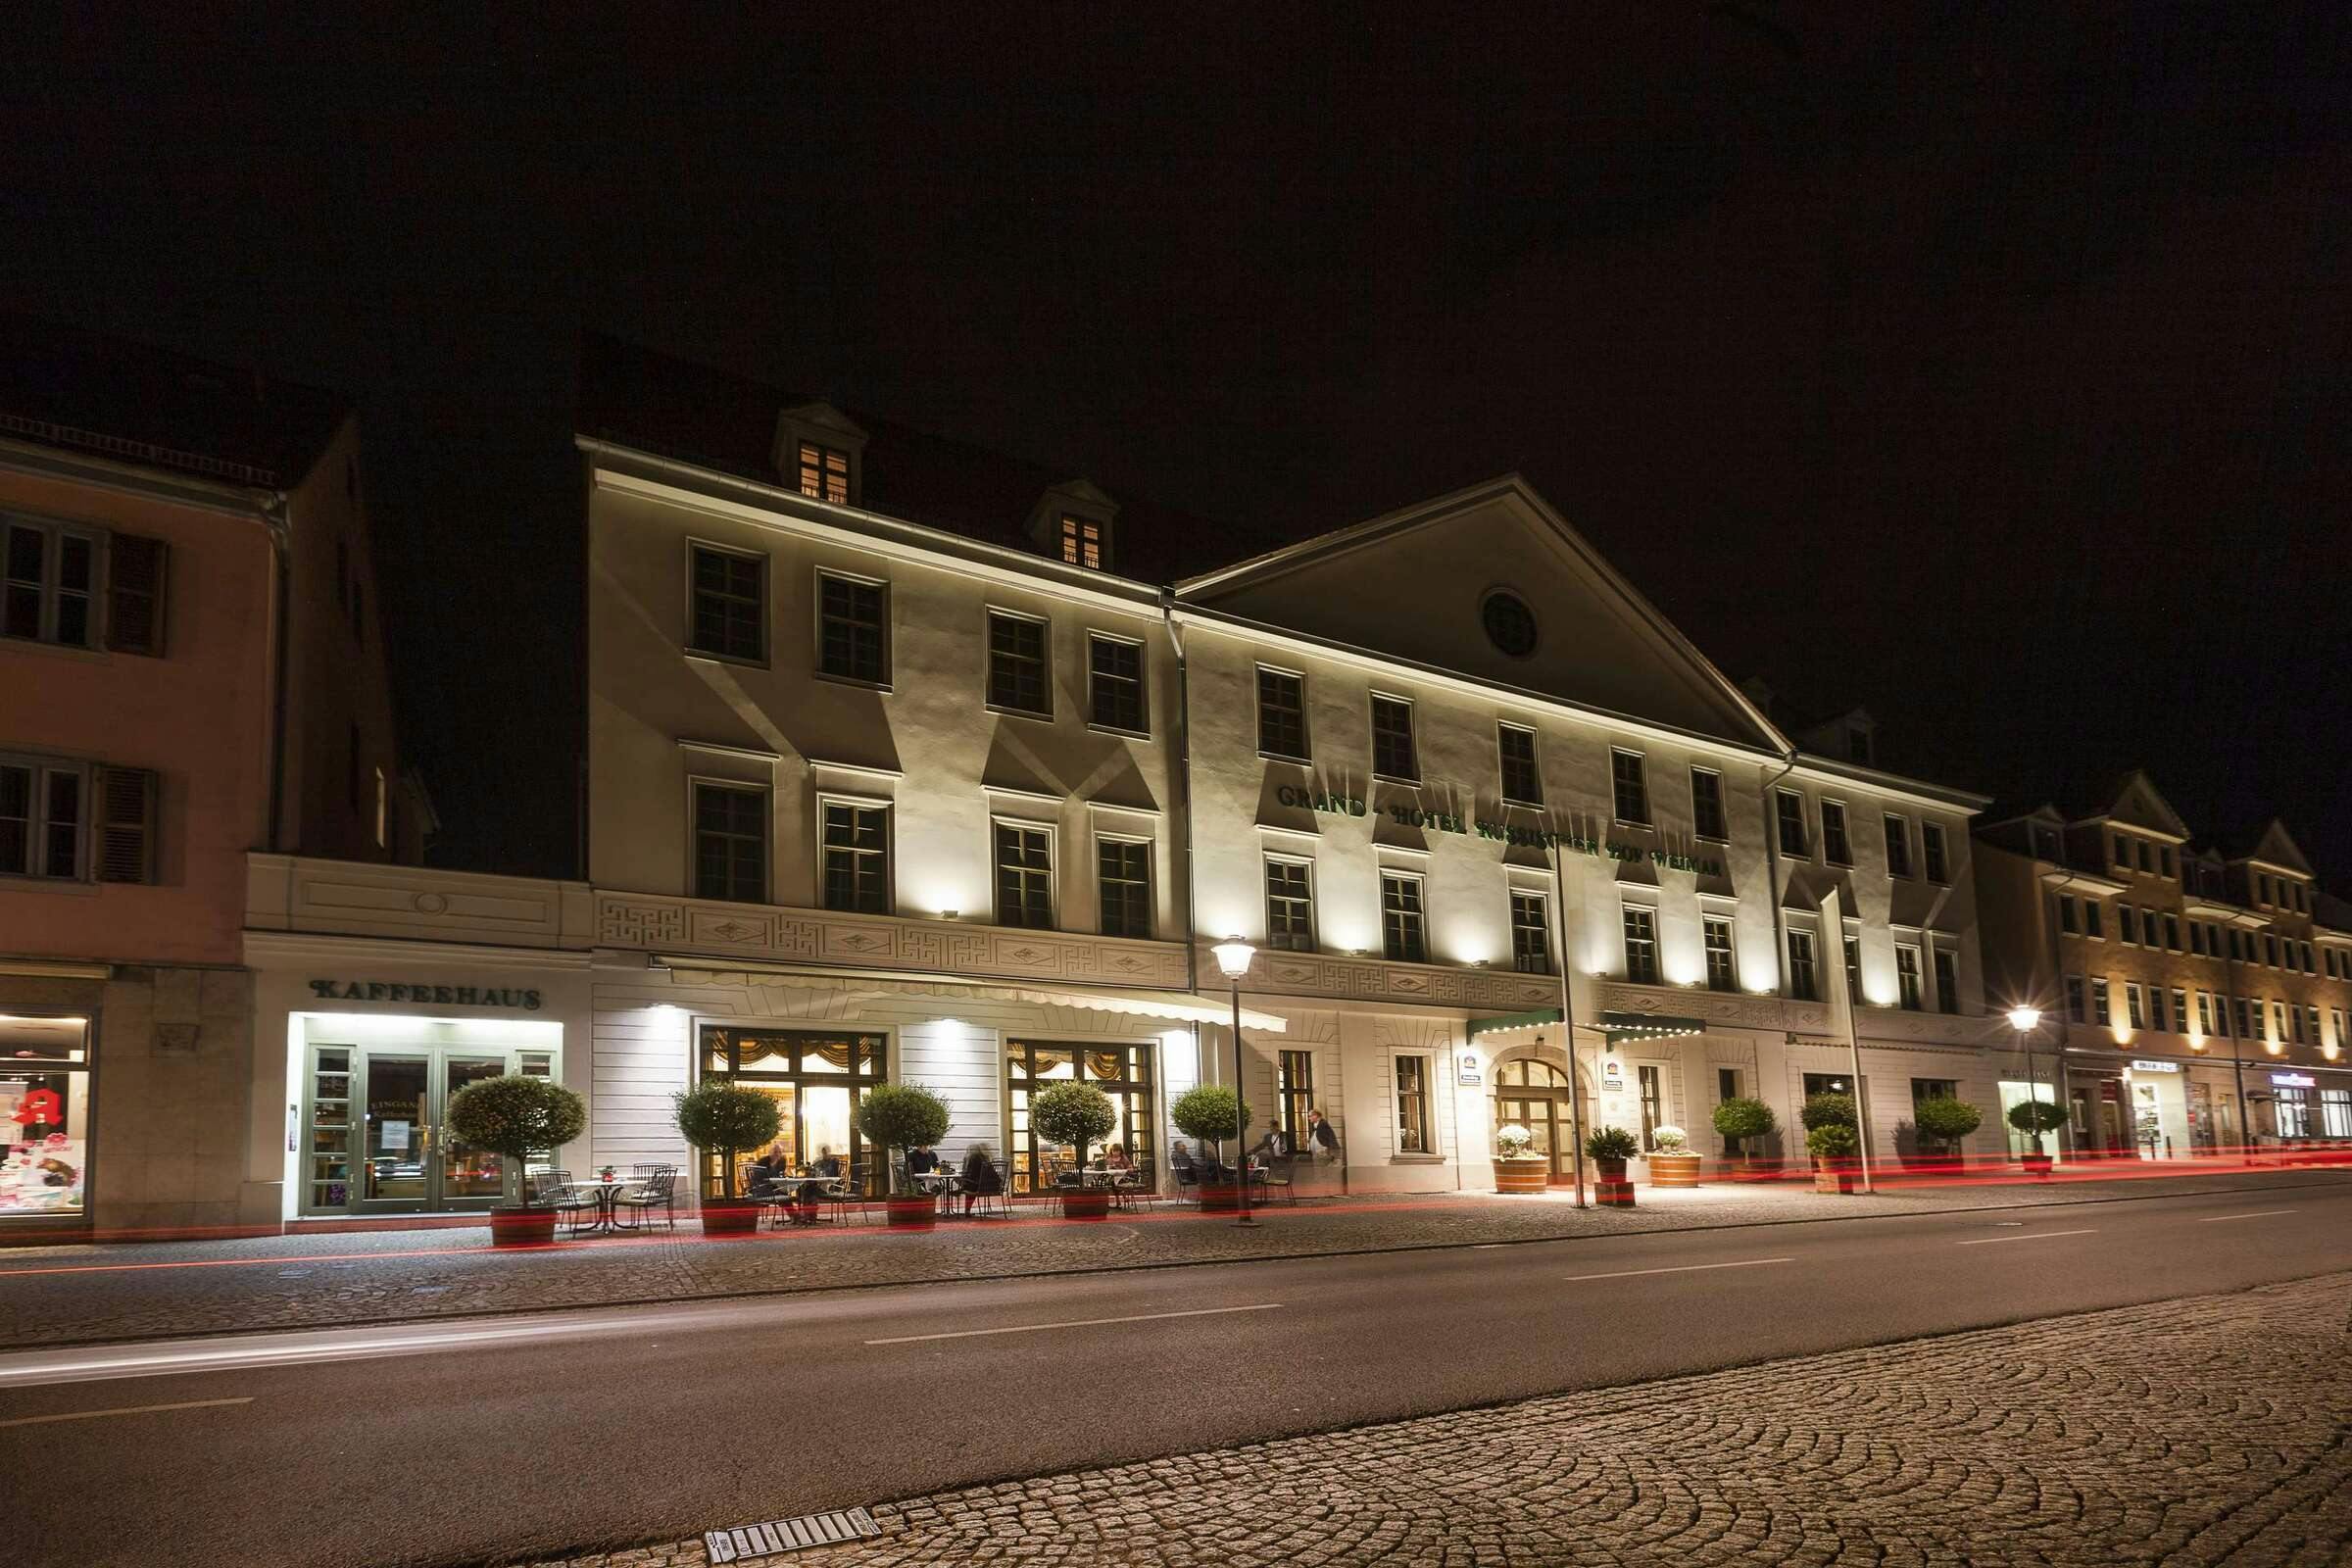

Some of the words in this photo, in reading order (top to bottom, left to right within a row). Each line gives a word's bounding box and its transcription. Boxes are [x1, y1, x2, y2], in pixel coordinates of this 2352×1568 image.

[1278, 786, 1368, 817] GRAND
[1390, 805, 1469, 834] HOTEL
[307, 980, 542, 1010] KAFFEEHAUS
[371, 1101, 422, 1110] EINGAN
